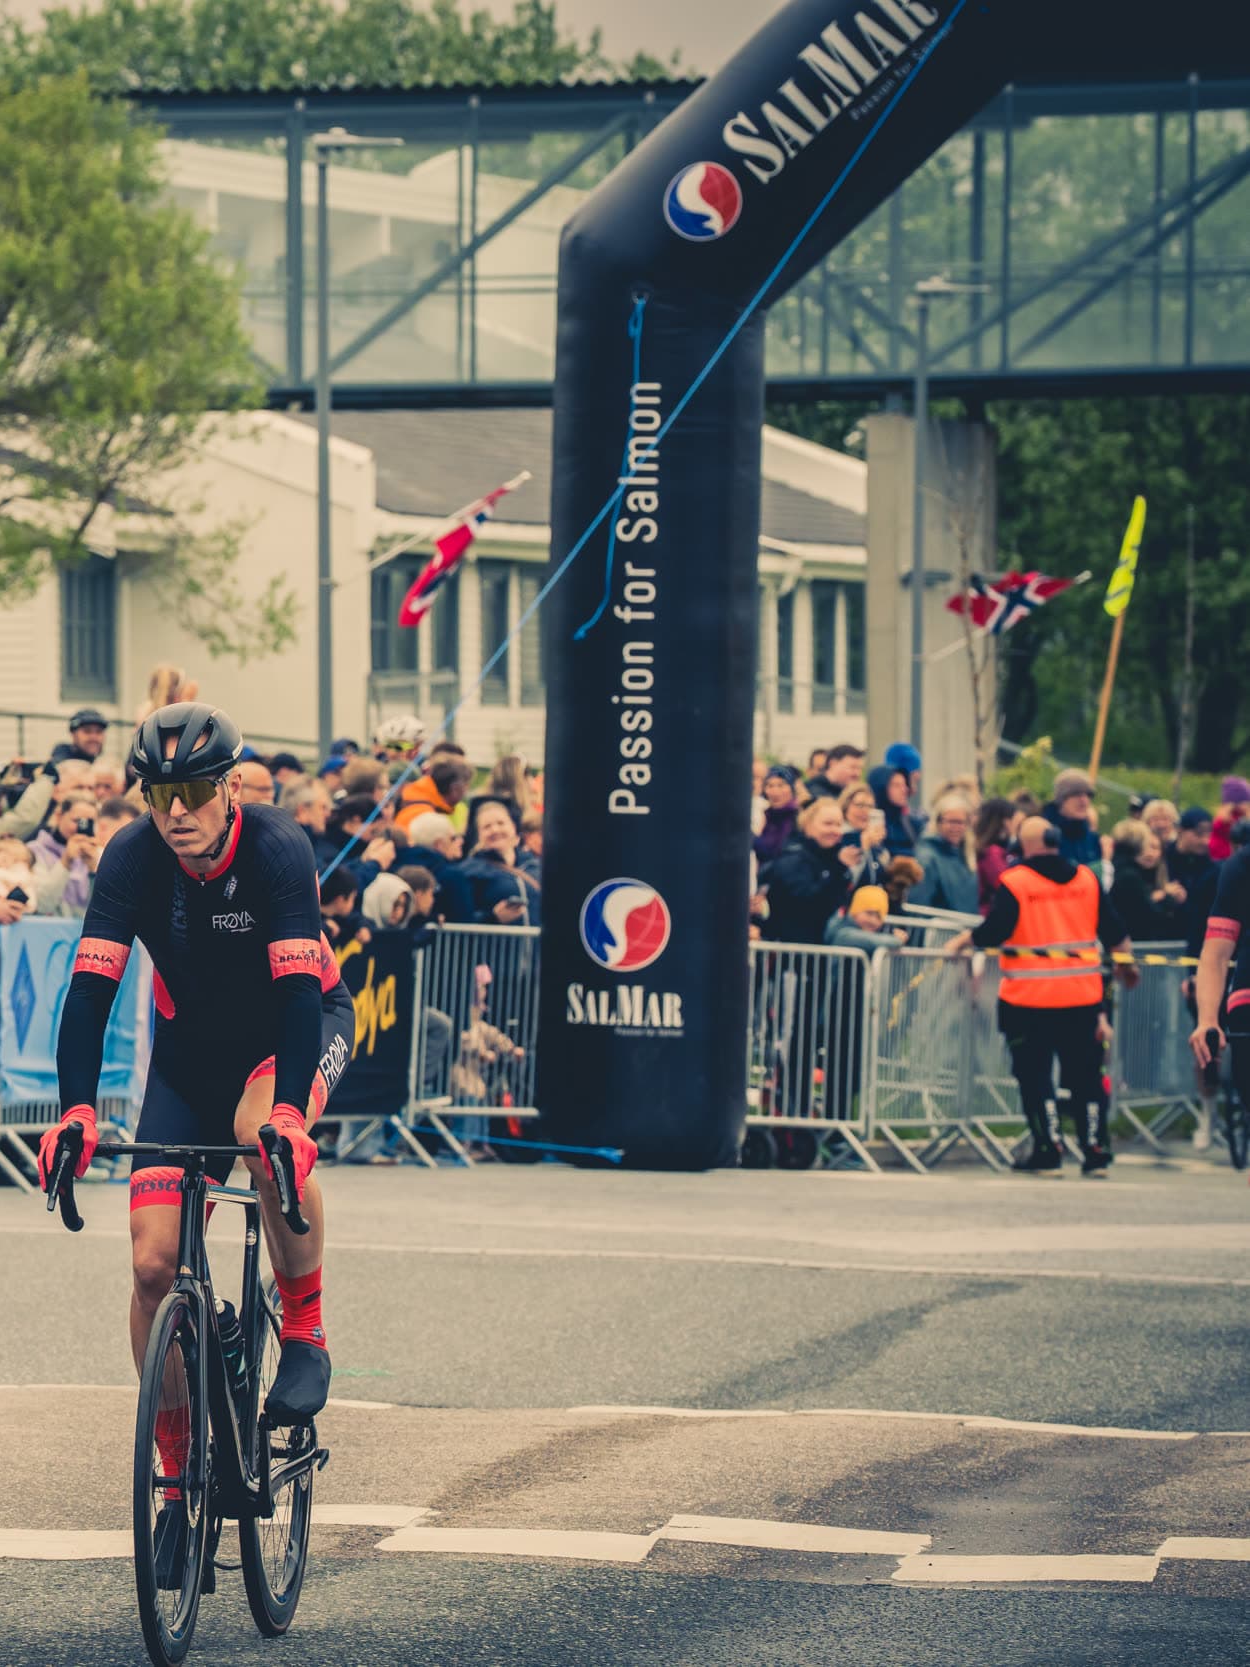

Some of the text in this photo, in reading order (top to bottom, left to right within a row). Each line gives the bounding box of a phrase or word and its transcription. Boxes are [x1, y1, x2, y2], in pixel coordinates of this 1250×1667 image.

[609, 382, 662, 815] Passion for Salmon
[212, 910, 256, 931] FRØYA
